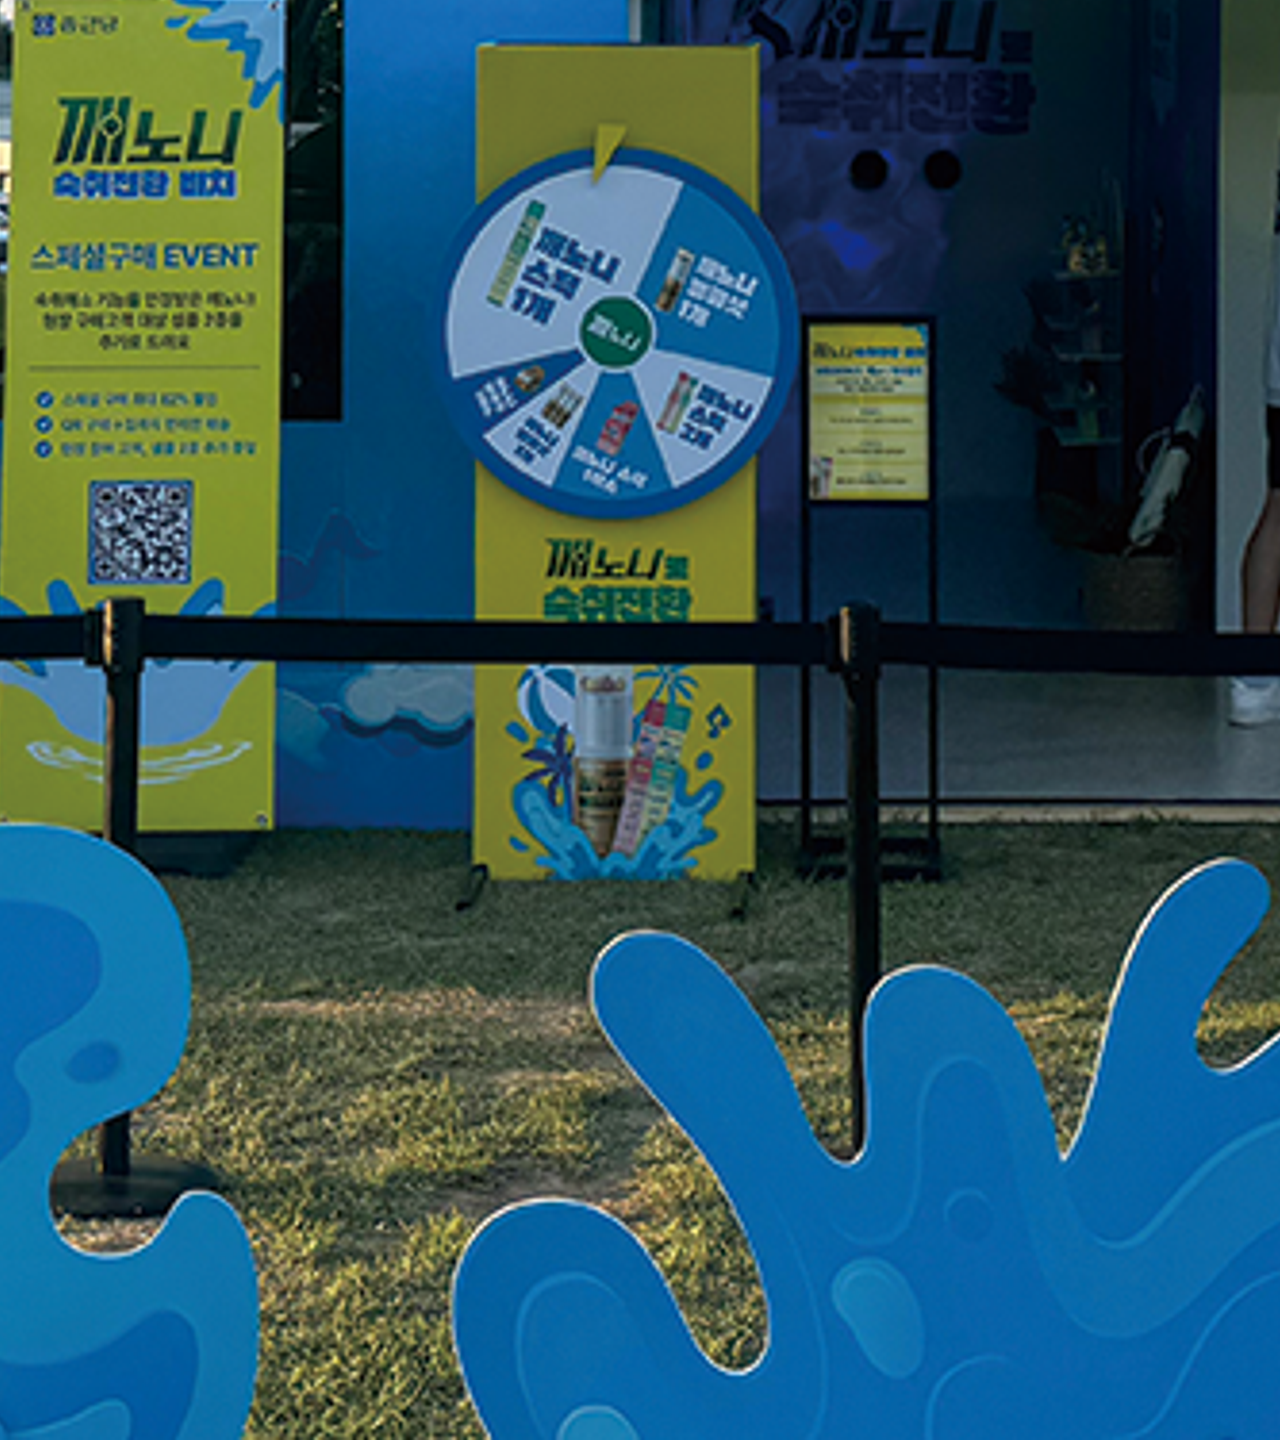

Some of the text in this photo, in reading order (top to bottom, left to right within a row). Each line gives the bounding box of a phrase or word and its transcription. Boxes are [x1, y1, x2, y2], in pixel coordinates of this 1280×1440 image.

[53, 96, 243, 166] 깨노니
[53, 170, 170, 198] 숙취전환
[164, 244, 259, 268] EVENT
[534, 227, 620, 283] 깨노니
[509, 289, 557, 326] 1개
